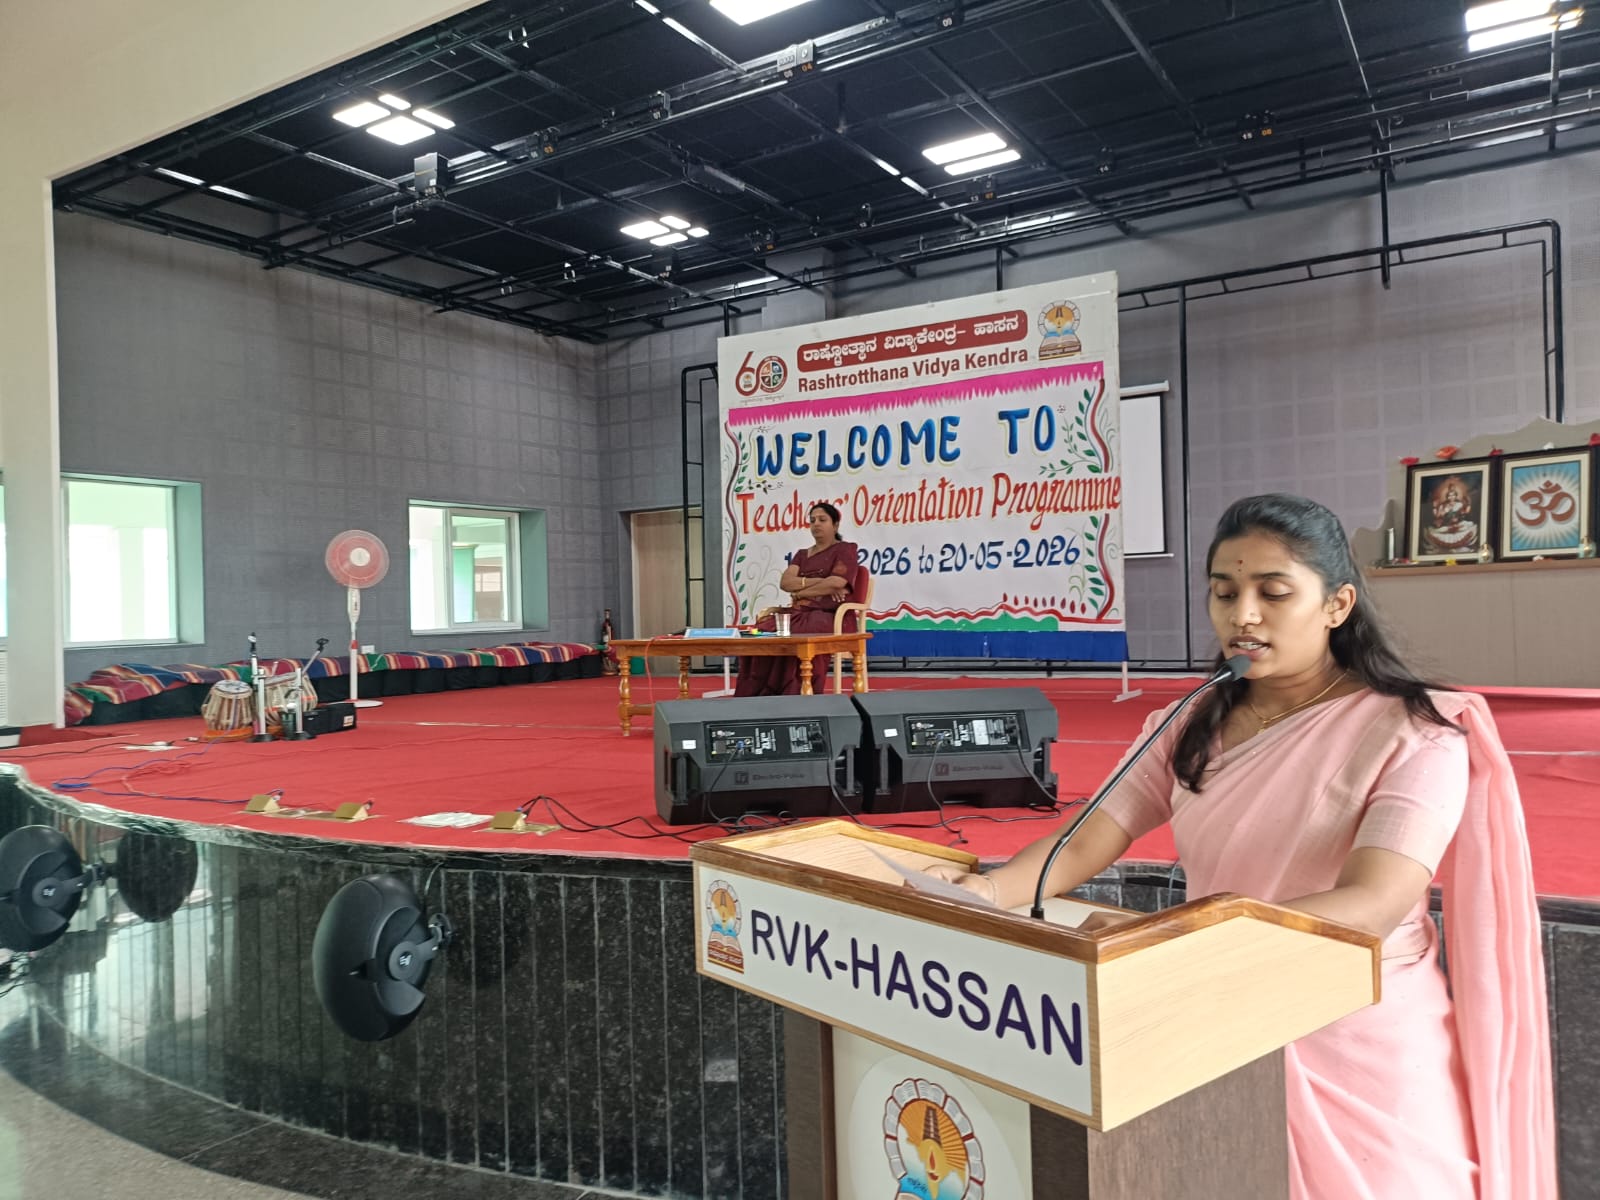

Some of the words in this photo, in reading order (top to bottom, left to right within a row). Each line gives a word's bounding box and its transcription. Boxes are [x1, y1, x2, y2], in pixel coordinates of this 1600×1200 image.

[973, 315, 1019, 337] ಹಾಸನ
[798, 365, 909, 393] Rashtrotthana
[912, 356, 961, 381] Vidya
[965, 346, 1028, 370] Kendra
[756, 415, 961, 477] WELCOME
[998, 404, 1056, 455] TO
[853, 476, 983, 528] Orientation
[991, 472, 1122, 531] Programme
[919, 544, 934, 573] to
[939, 535, 1081, 573] 20-05-2026
[751, 909, 1083, 1066] RVK-HASSAN
